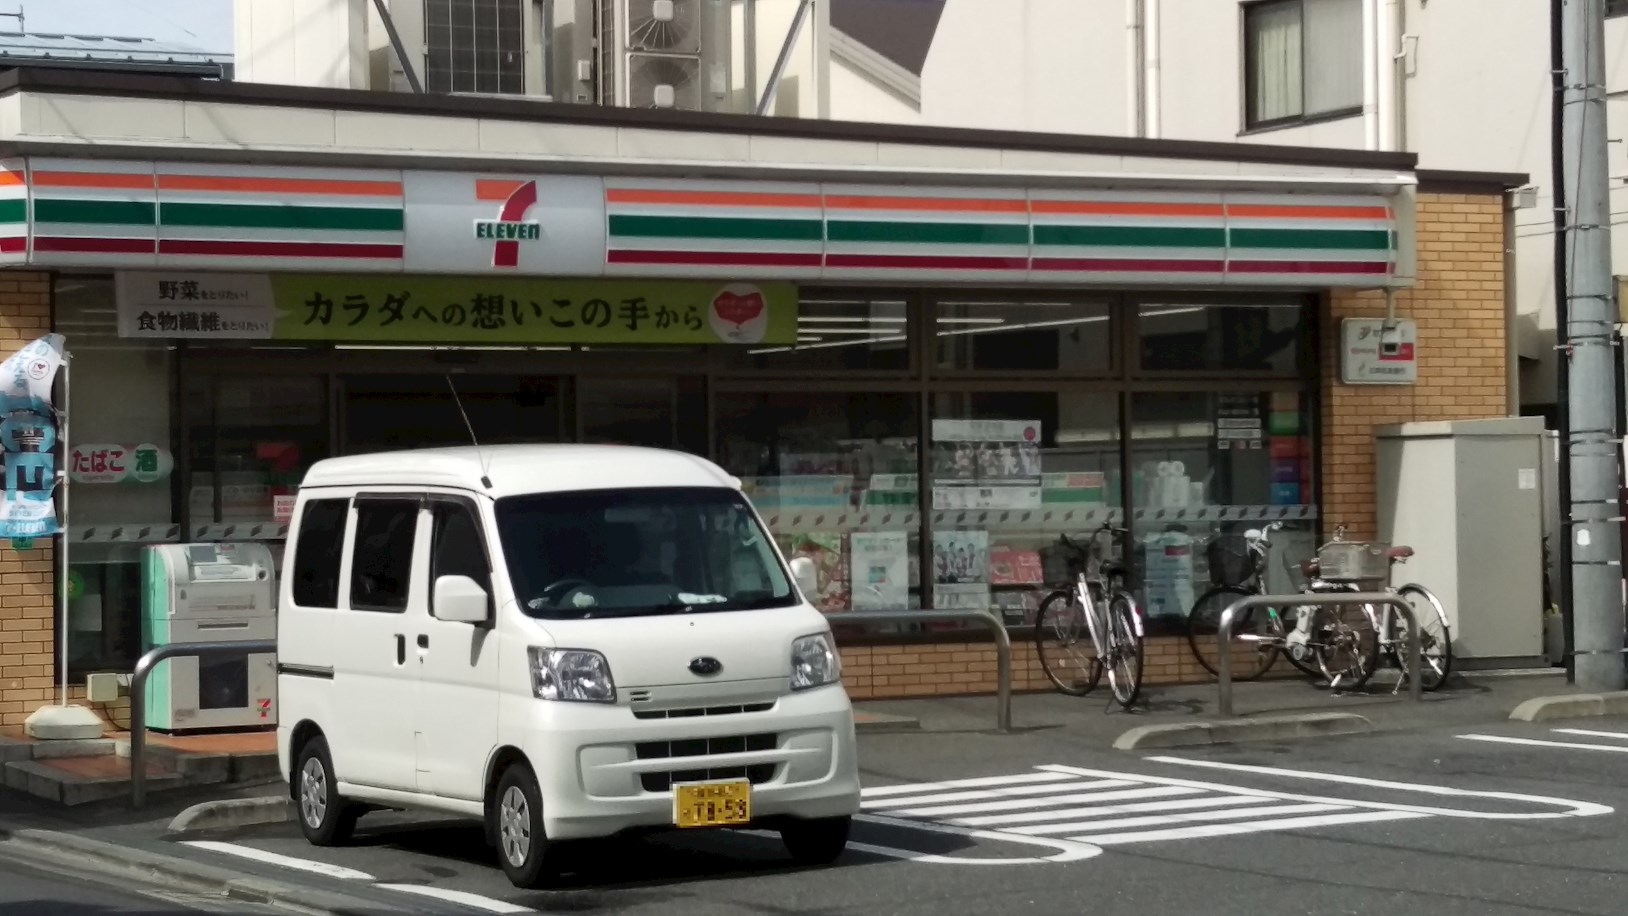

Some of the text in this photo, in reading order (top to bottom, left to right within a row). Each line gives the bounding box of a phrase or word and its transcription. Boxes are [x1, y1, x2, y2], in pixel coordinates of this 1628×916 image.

[476, 180, 537, 266] 7
[303, 291, 703, 331] カラダへの想いこの手から
[72, 449, 158, 473] たばこ 酒
